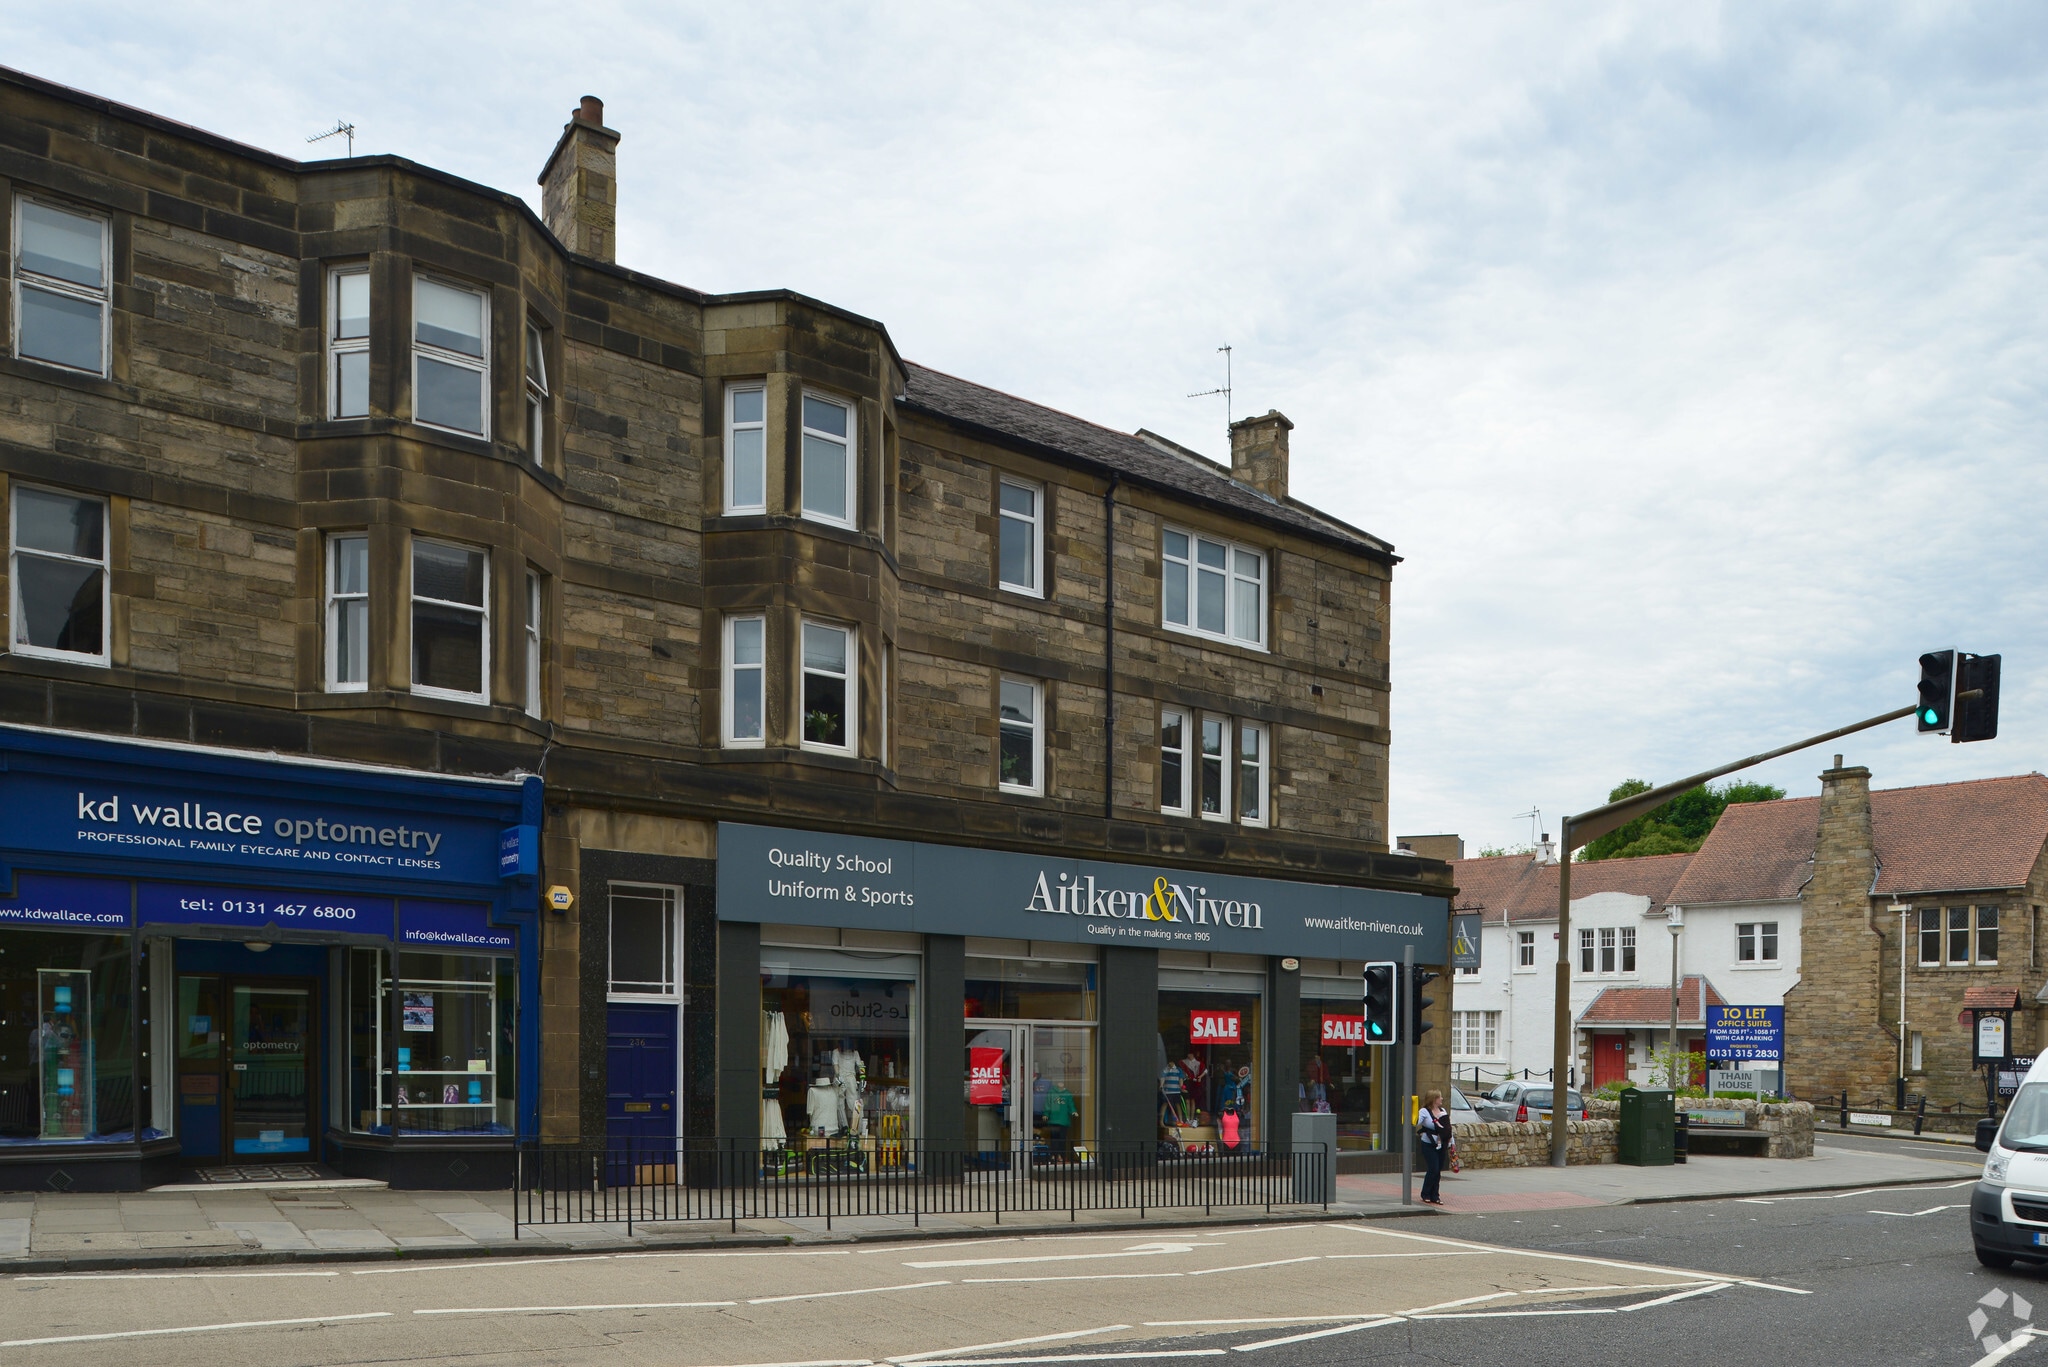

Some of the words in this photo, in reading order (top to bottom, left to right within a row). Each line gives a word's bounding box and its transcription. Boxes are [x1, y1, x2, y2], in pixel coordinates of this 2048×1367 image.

[78, 792, 118, 822] kd
[132, 802, 262, 835] wallace
[274, 818, 442, 856] optometry
[78, 830, 186, 848] PROFESSIONAL
[190, 840, 236, 852] FAMILY
[240, 844, 300, 858] EYECARE
[303, 850, 330, 860] AND
[334, 852, 394, 865] CONTACT
[398, 858, 441, 870] LENSES
[502, 853, 519, 868] optometry
[768, 848, 832, 874] Quality
[836, 854, 892, 874] School
[554, 894, 568, 903] ADT
[768, 880, 839, 900] Uniform
[844, 886, 857, 902] &
[861, 888, 914, 906] Sports
[180, 898, 214, 912] tel:
[222, 900, 265, 914] 0131
[274, 904, 306, 916] 467
[313, 906, 356, 920] 6800
[1087, 924, 1116, 937] Quality
[1118, 926, 1126, 936] in
[1128, 927, 1141, 937] the
[1144, 928, 1171, 941] making
[1174, 930, 1192, 941] since
[1194, 932, 1210, 942] 1905
[1304, 916, 1424, 936] www.aitken-niven.co.uk
[1456, 920, 1470, 938] A
[406, 930, 510, 945] info@kdwallace.com
[1722, 1008, 1741, 1019] TO
[1746, 1008, 1766, 1019] LET
[1193, 1016, 1238, 1038] SALE
[1323, 1020, 1363, 1040] SALE
[243, 1040, 300, 1051] optometry
[630, 1038, 646, 1046] 236
[972, 1067, 1000, 1078] SALE
